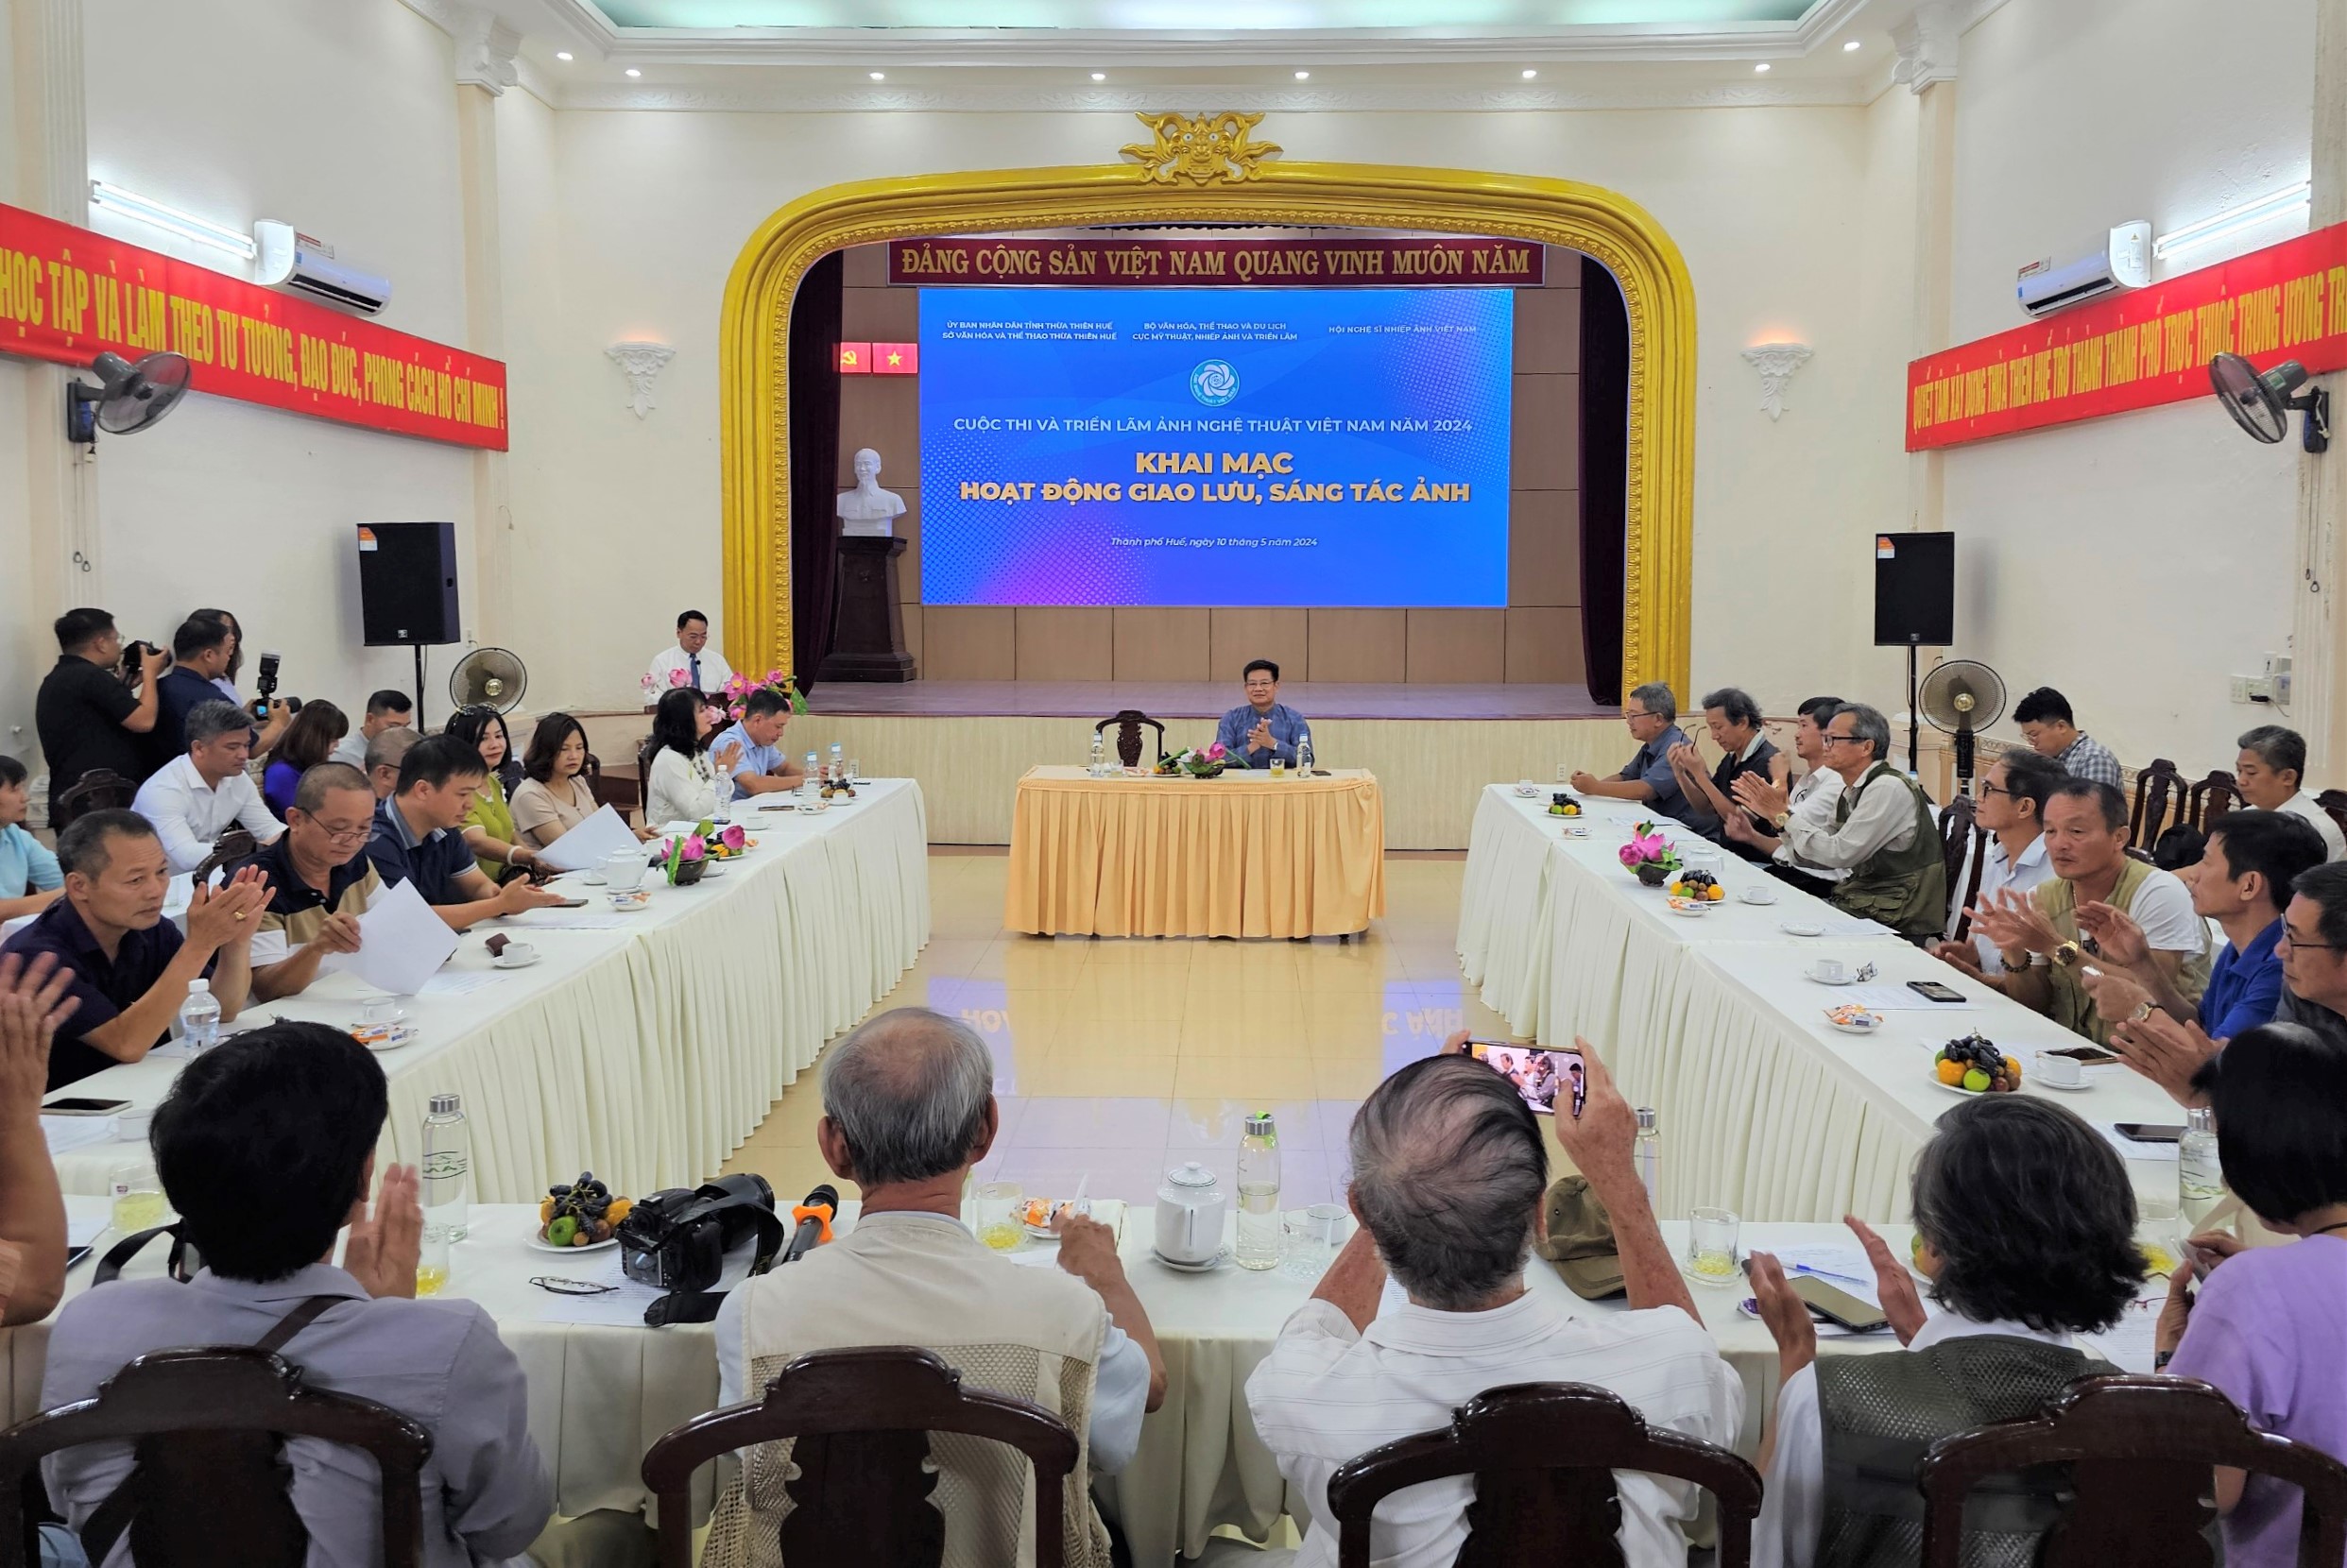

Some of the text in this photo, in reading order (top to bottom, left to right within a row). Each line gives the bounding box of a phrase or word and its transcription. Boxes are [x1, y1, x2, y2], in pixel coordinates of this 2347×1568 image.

[901, 243, 1529, 281] ĐẢNG CỘNG SẢN VIỆT NAM QUANG VINH MUÔN NĂM
[1070, 321, 1094, 330] THIÊN
[1096, 321, 1113, 330] HUẾ
[1143, 322, 1156, 331] BỘ
[1176, 322, 1197, 331] HÓA,
[1267, 322, 1287, 331] LỊCH
[1328, 325, 1345, 334] HỘI
[1346, 325, 1372, 334] NGHỆ
[1384, 324, 1412, 332] NHIẾP
[1434, 325, 1454, 333] VIỆT
[2105, 314, 2138, 387] THÀNH
[2139, 295, 2164, 380] PHỐ
[2164, 309, 2194, 384] TRỰC
[2238, 284, 2281, 357] TRUNG
[2283, 271, 2324, 349] ƯƠNG
[0, 247, 43, 338] HỌC
[47, 248, 89, 348] TẬP
[94, 259, 122, 343] VÀ
[126, 268, 166, 352] LÀM
[169, 295, 214, 365] THEO
[216, 308, 239, 370] TƯ
[241, 304, 298, 392] TƯỞNG,
[300, 333, 328, 401] ĐẠO
[331, 332, 362, 406] ĐỨC,
[364, 351, 404, 409] PHONG
[406, 352, 436, 417] CÁCH
[437, 355, 453, 420] HỒ
[454, 366, 471, 423] CHÍ
[1073, 332, 1098, 340] THIÊN
[1100, 332, 1118, 340] HUẾ
[1132, 332, 1150, 342] CỤC
[953, 416, 1473, 435] CUỘC THI VÀ TRIỂN LÃM ẢNH NGHỆ THUẬT VIỆT NAM NĂM 2024
[1136, 452, 1294, 480] KHAI MẠC
[959, 476, 1471, 506] HOẠT ĐỘNG GIAO LƯU, SÁNG TÁC ẢNH
[1110, 537, 1142, 546] Thành
[1143, 537, 1164, 548] phố
[1165, 537, 1188, 547] Huế,
[1190, 537, 1215, 548] ngày
[1216, 537, 1226, 546] 10
[1228, 537, 1259, 548] tháng
[1268, 537, 1292, 546] năm
[1293, 537, 1318, 546] 2024
